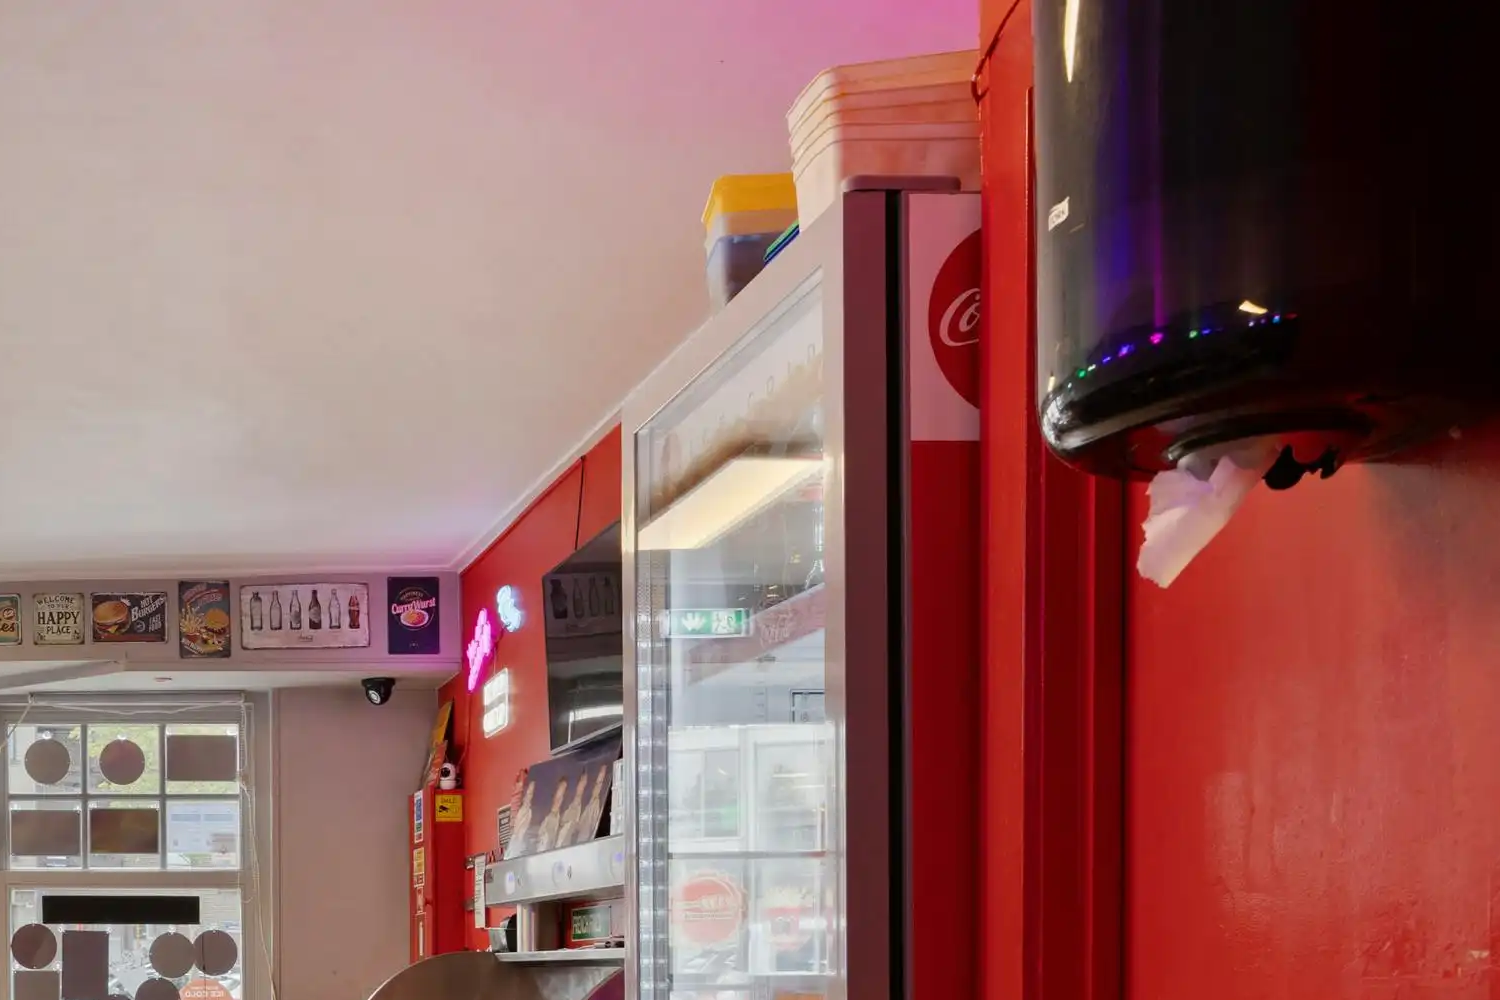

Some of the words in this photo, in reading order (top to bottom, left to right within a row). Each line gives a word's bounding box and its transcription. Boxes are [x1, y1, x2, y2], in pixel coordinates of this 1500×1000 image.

[36, 595, 75, 605] WELCOME
[140, 595, 153, 608] HOT
[130, 596, 167, 621] BURGERS
[37, 611, 80, 625] HAPPY
[46, 626, 72, 635] PLACE
